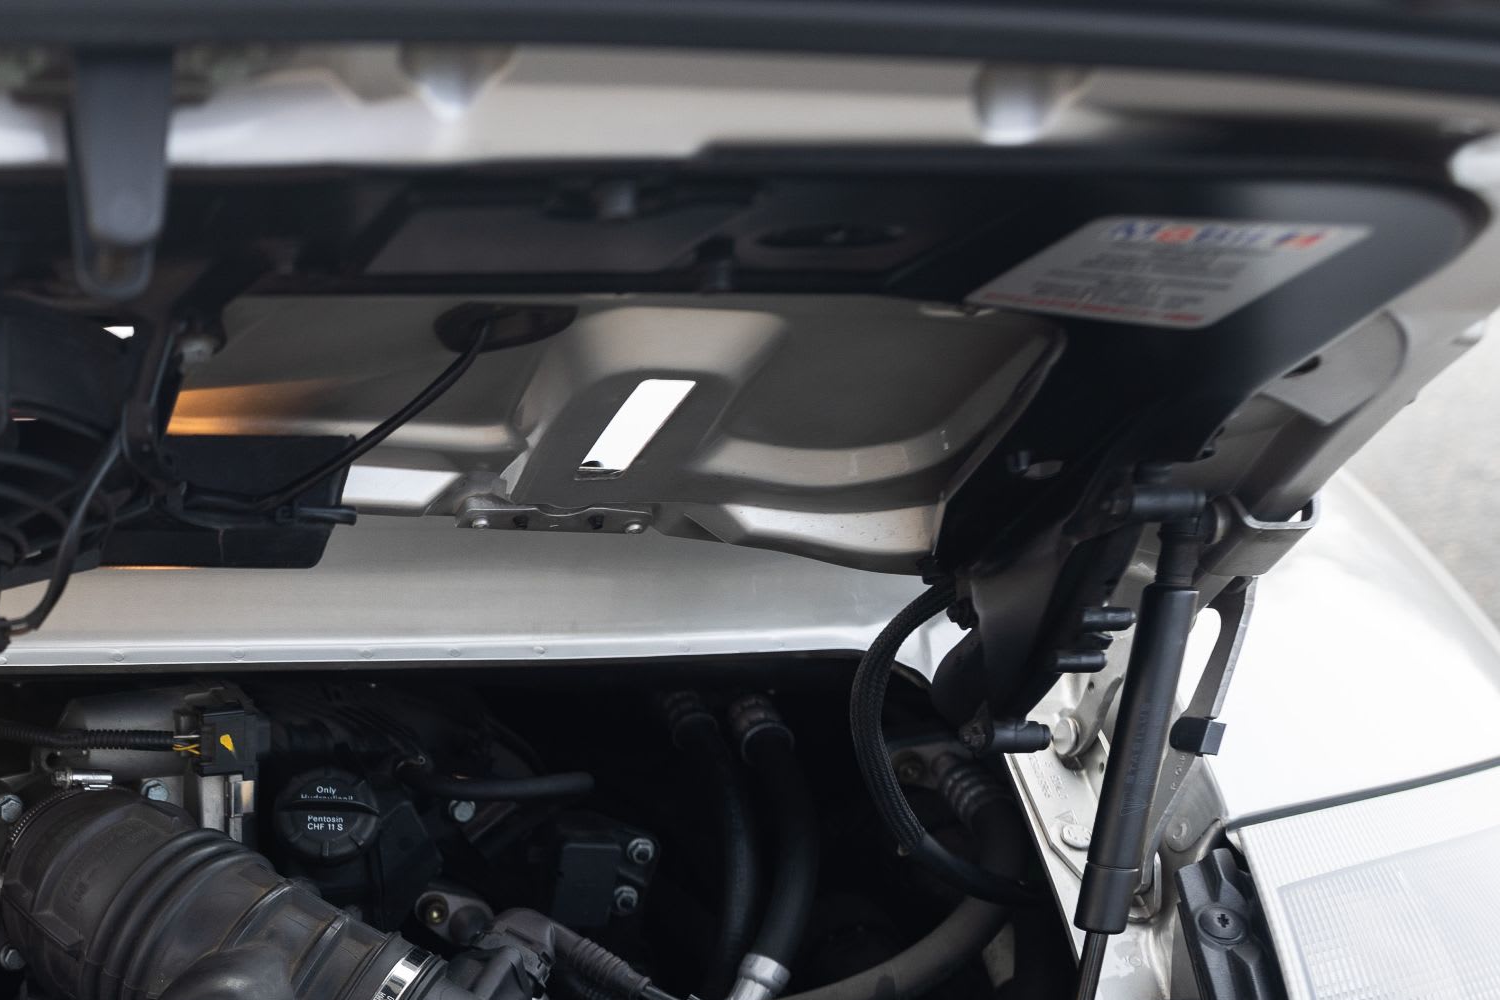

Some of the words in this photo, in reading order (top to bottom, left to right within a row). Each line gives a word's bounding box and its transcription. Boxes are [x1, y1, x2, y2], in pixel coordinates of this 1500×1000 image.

[316, 786, 337, 795] Only
[307, 815, 344, 823] Pentosin
[307, 823, 325, 831] CHF
